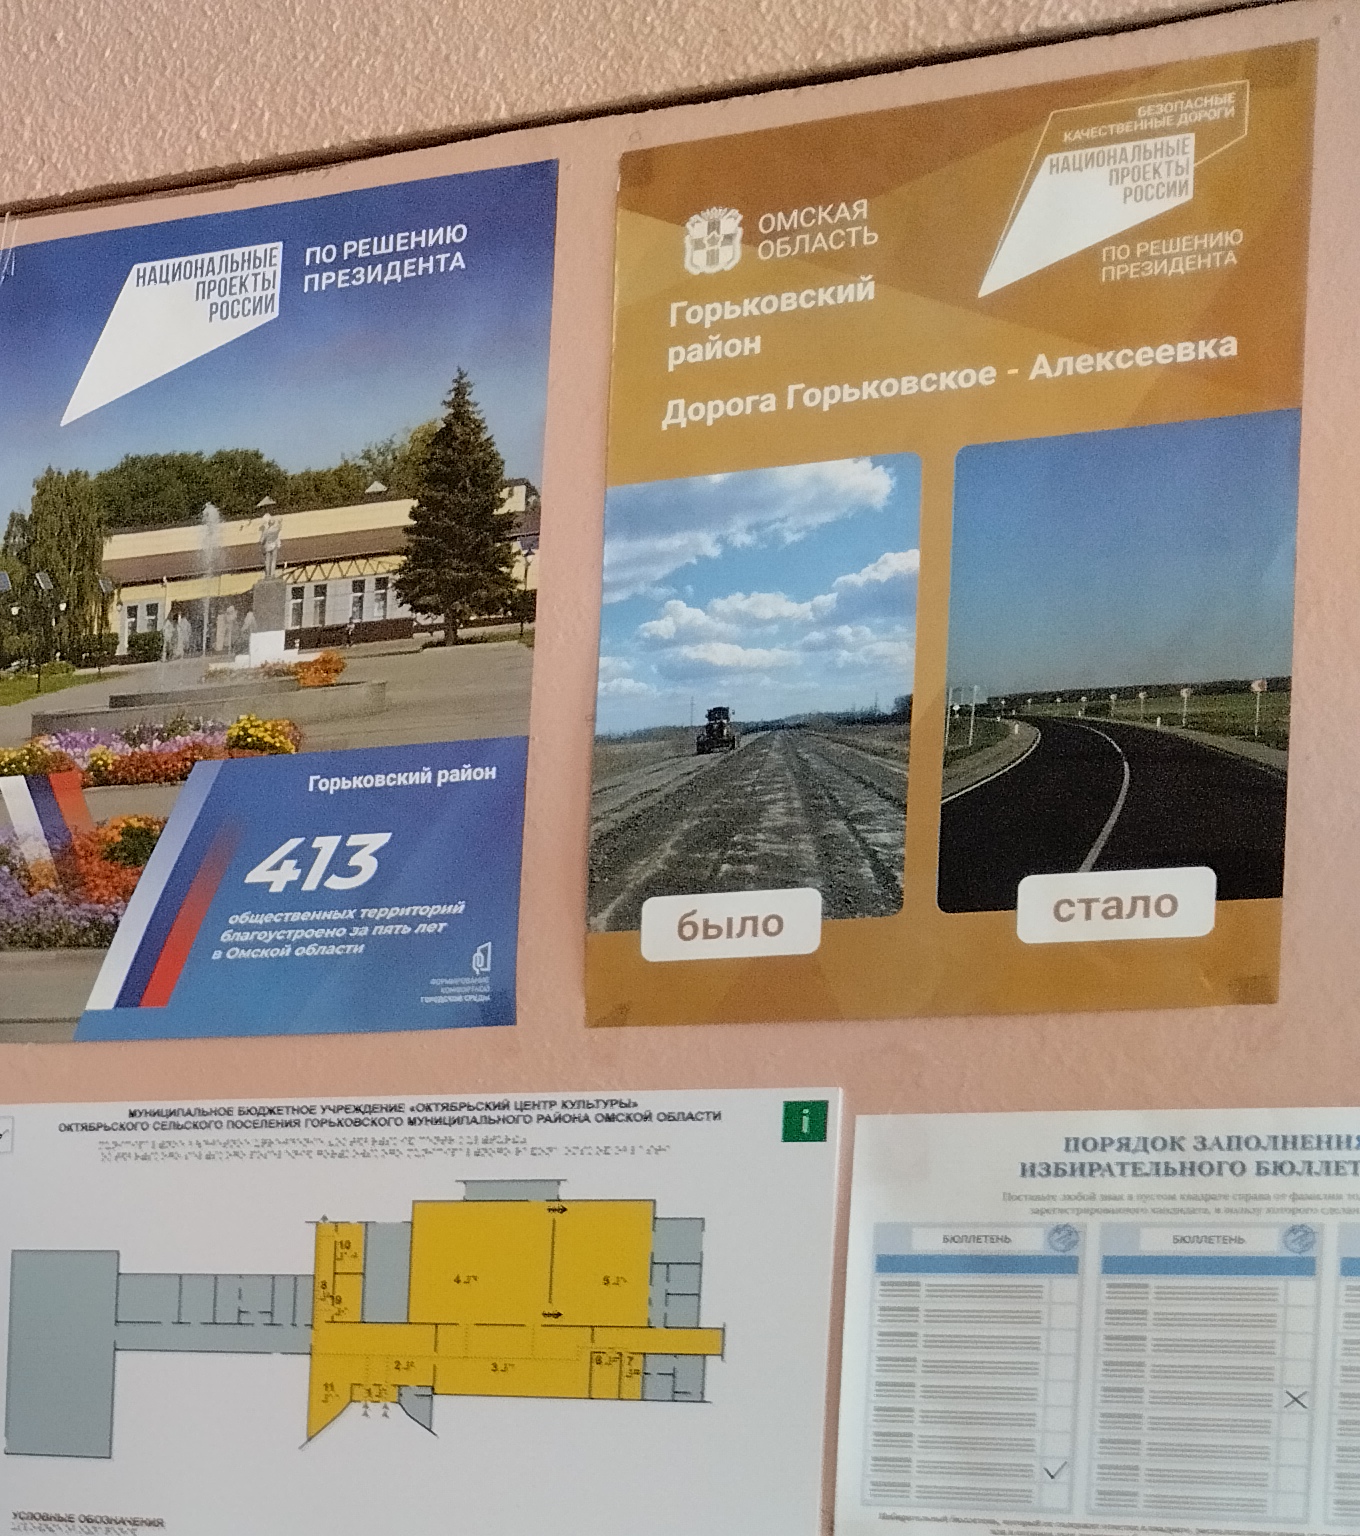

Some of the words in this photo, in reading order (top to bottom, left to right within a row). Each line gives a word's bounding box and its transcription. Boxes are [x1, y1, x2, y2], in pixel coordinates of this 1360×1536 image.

[1136, 92, 1236, 119] БЕЗОПАСНЫЕ
[1063, 114, 1174, 143] КАЧЕСТВЕННЫЕ
[1176, 106, 1236, 128] ДОРОГИ
[1048, 136, 1191, 176] НАЦИОНАЛЬНЫЕ
[1108, 157, 1191, 187] ПРОЕКТЫ
[1123, 179, 1190, 205] РОССИИ
[757, 199, 869, 236] ОМСКАЯ
[304, 244, 338, 266] ПО
[343, 223, 469, 260] РЕШЕНИЮ
[757, 227, 879, 262] ОБЛАСТЬ
[1102, 243, 1130, 263] ПО
[1136, 229, 1245, 260] РЕШЕНИЮ
[135, 246, 279, 287] НАЦИОНАЛЬНЫЕ
[302, 252, 466, 294] ПРЕЗИДЕНТА
[1100, 250, 1238, 283] ПРЕЗИДЕНТА
[194, 275, 277, 302] ПРОЕКТЫ
[668, 275, 877, 328] Горьковский
[208, 298, 276, 323] РОССИИ
[666, 333, 762, 373] район
[661, 389, 778, 431] Дорога
[785, 361, 998, 415] Горьковское
[1028, 333, 1239, 381] Алексеевка
[307, 766, 433, 796] Горьковский
[436, 764, 497, 788] район
[244, 831, 393, 893] 413
[228, 908, 356, 925] общественных
[359, 900, 466, 919] территорий
[1052, 892, 1179, 924] стало
[220, 928, 347, 943] благоустроено
[349, 926, 370, 937] за
[372, 923, 412, 936] пять
[415, 922, 448, 935] лет
[677, 908, 785, 943] было
[211, 950, 223, 960] в
[225, 944, 292, 960] Омской
[294, 943, 365, 957] области
[58, 1121, 150, 1133] ОКТЯБРЬСКОГО
[152, 1119, 224, 1131] СЕЛЬСКОГО
[226, 1117, 301, 1130] ПОСЕЛЕНИЯ
[304, 1116, 404, 1128] ГОРЬКОВСКОГО
[407, 1113, 533, 1127] МУНИЦИПАЛЬНОГО
[536, 1111, 592, 1124] РАЙОНА
[594, 1109, 654, 1123] ОМСКОЙ
[656, 1110, 723, 1122] ОБЛАСТИ
[128, 1107, 233, 1119] МУНИЦИПАЛЬНОЕ
[237, 1104, 317, 1117] БЮДЖЕТНОЕ
[320, 1103, 406, 1116] УЧРЕЖДЕНИЕ
[409, 1098, 511, 1113] «ОКТЯБРЬСКИЙ
[514, 1099, 558, 1112] ЦЕНТР
[560, 1098, 639, 1110] КУЛЬТУРЫ»
[1064, 1135, 1186, 1154] ПОРЯДОК
[1019, 1160, 1247, 1178] ИЗБИРАТЕЛЬНОГО
[1254, 1160, 1360, 1177] БЮЛЛЕТ
[942, 1234, 1012, 1244] БЮЛЛЕТЕНЬ
[1172, 1234, 1245, 1245] БЮЛЛЕТЕНЬ
[11, 1511, 76, 1524] УСЛОВНЫЕ
[78, 1514, 165, 1528] ОБОЗНАЧЕНИЯ
